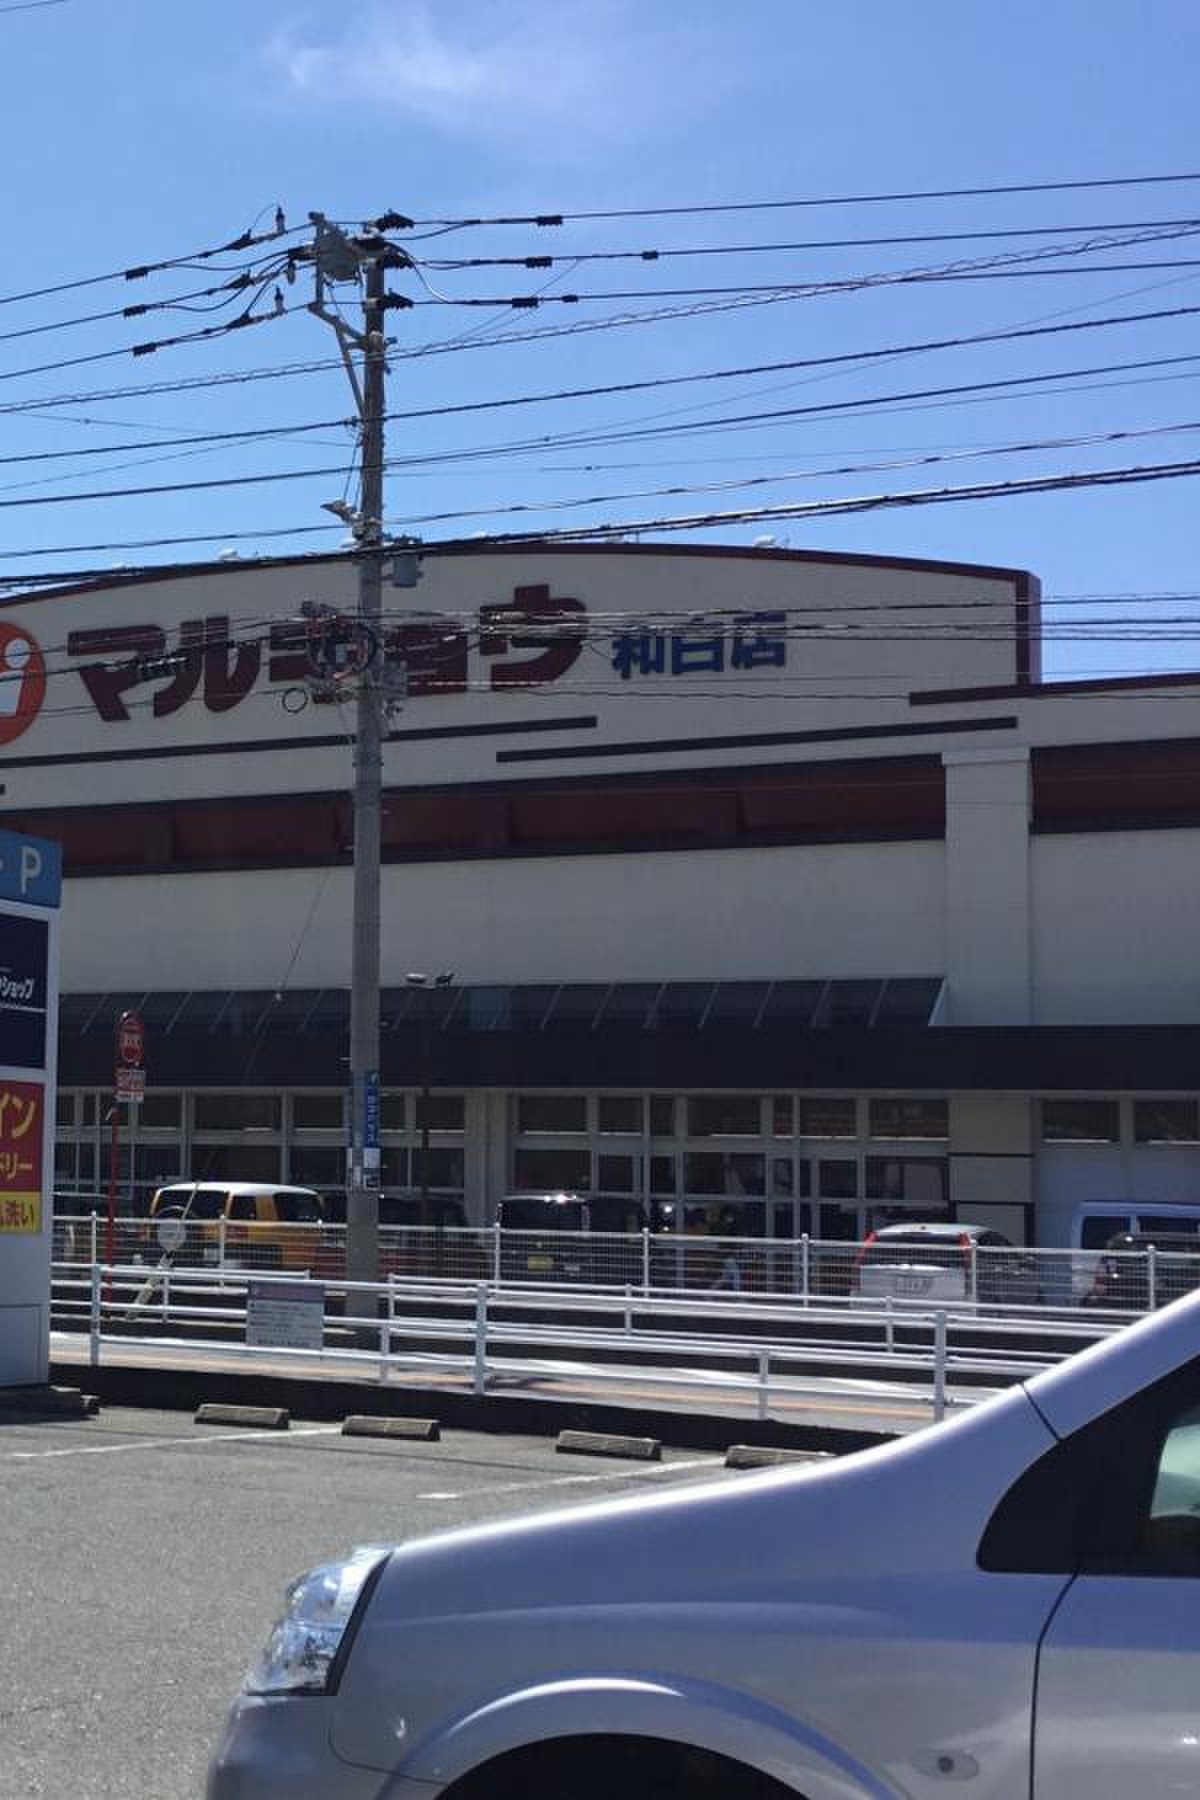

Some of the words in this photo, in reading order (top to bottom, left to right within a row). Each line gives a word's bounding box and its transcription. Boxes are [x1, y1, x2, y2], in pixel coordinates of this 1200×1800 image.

[611, 611, 787, 680] 和白店
[20, 845, 42, 895] P
